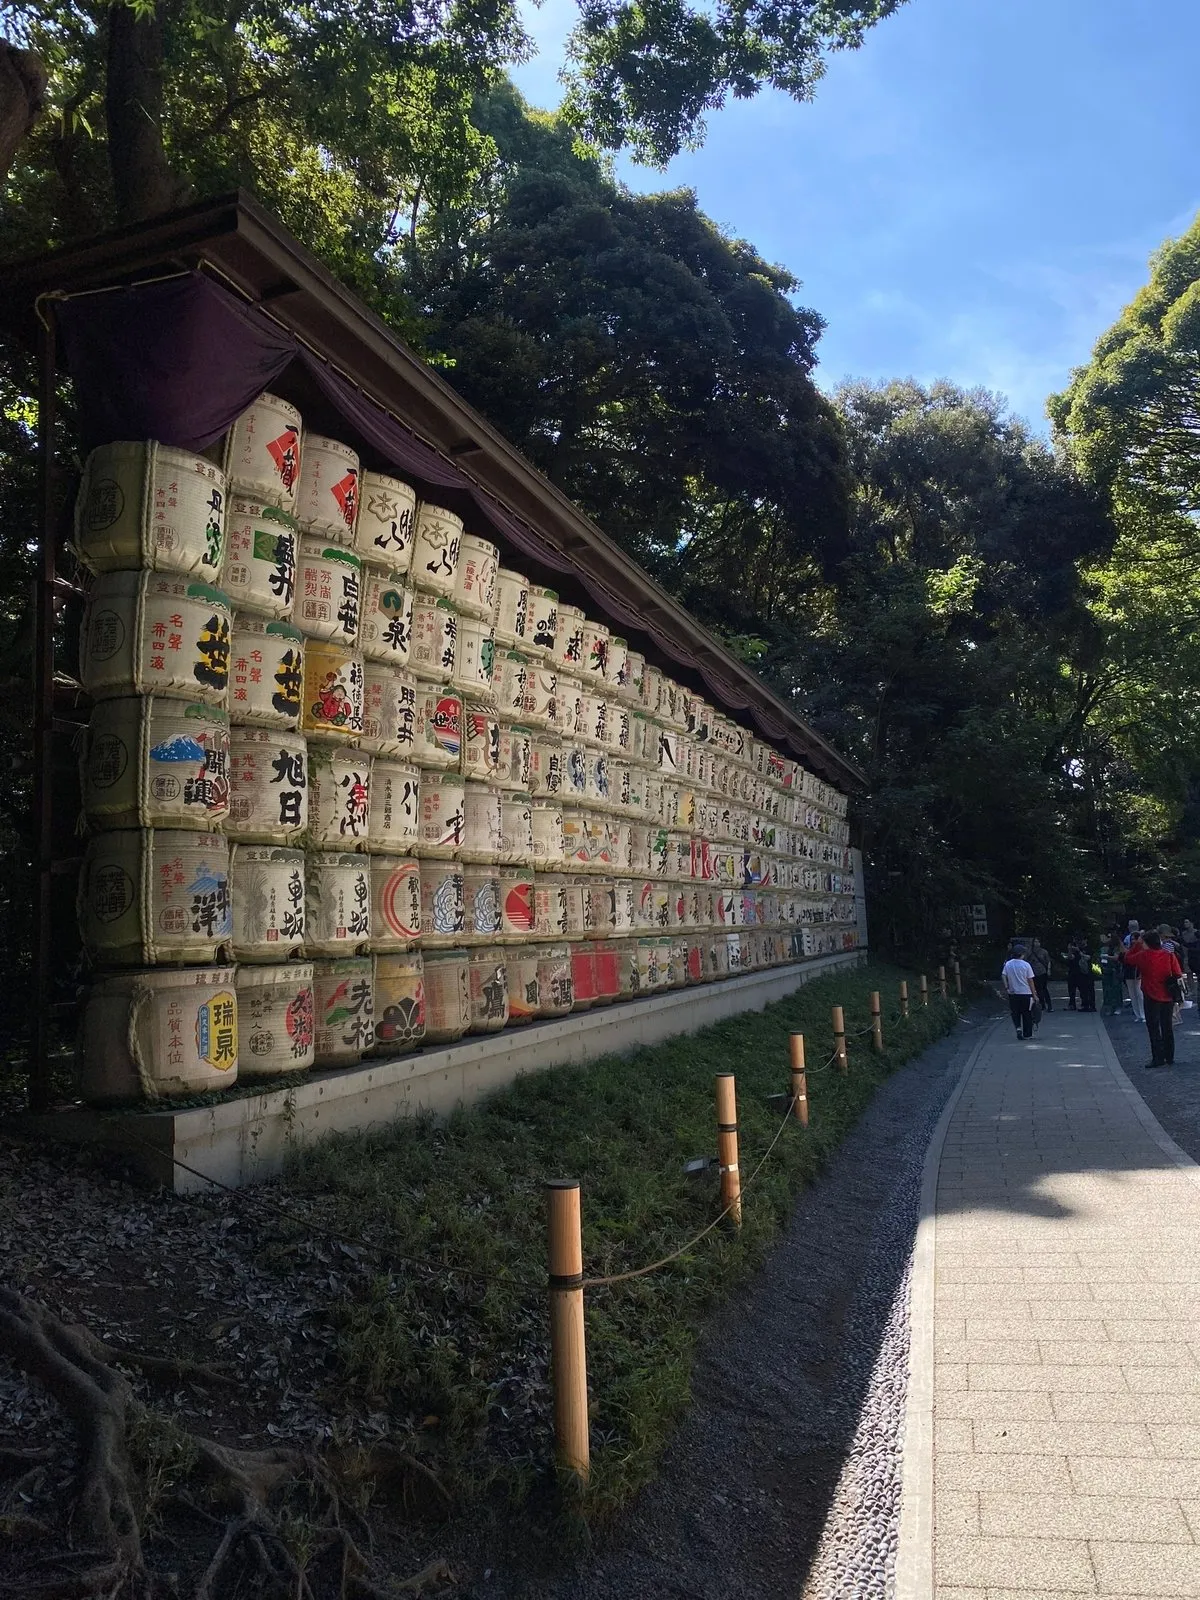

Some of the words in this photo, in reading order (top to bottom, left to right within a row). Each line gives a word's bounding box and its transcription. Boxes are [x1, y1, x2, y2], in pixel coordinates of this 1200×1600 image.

[270, 749, 306, 827] 旭日
[167, 1002, 184, 1065] 品質本位
[213, 1000, 235, 1061] 瑞泉
